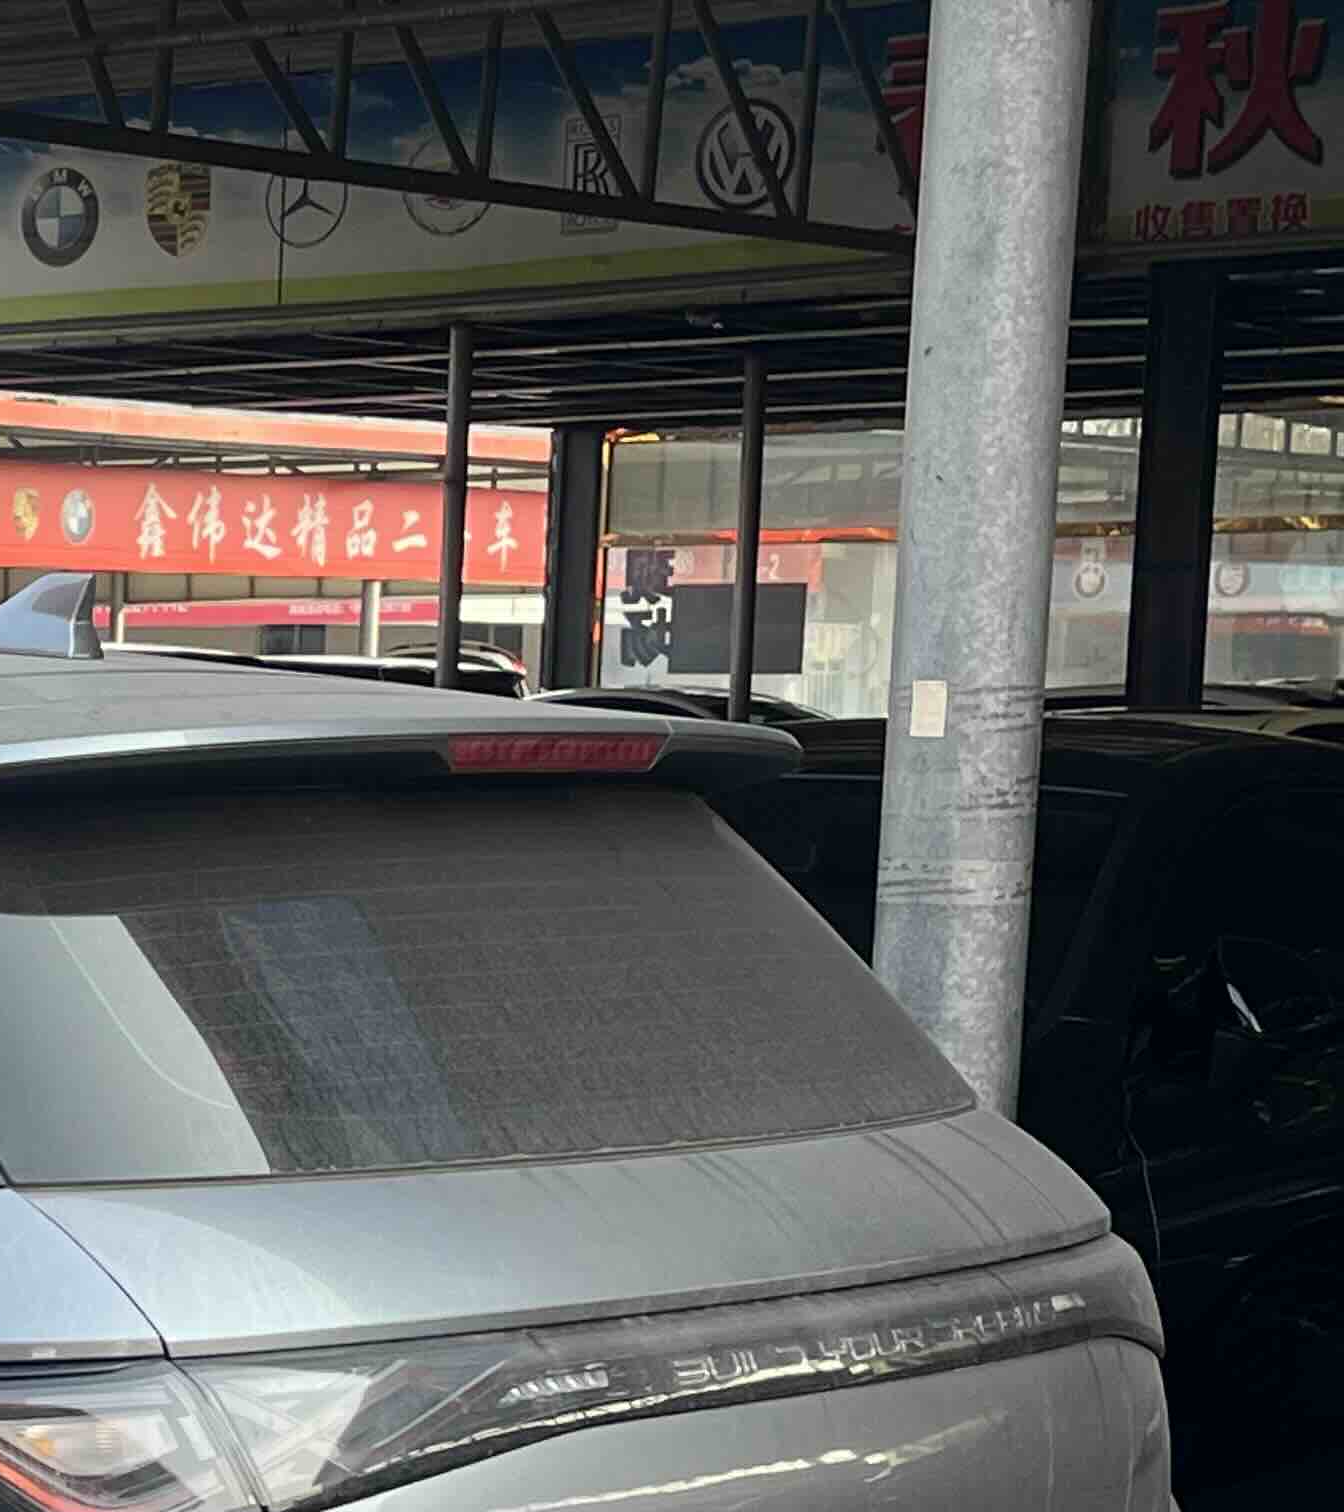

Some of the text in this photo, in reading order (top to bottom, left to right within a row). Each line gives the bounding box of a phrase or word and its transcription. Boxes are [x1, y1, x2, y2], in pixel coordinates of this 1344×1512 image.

[135, 482, 520, 573] 鑫伟达精品二车
